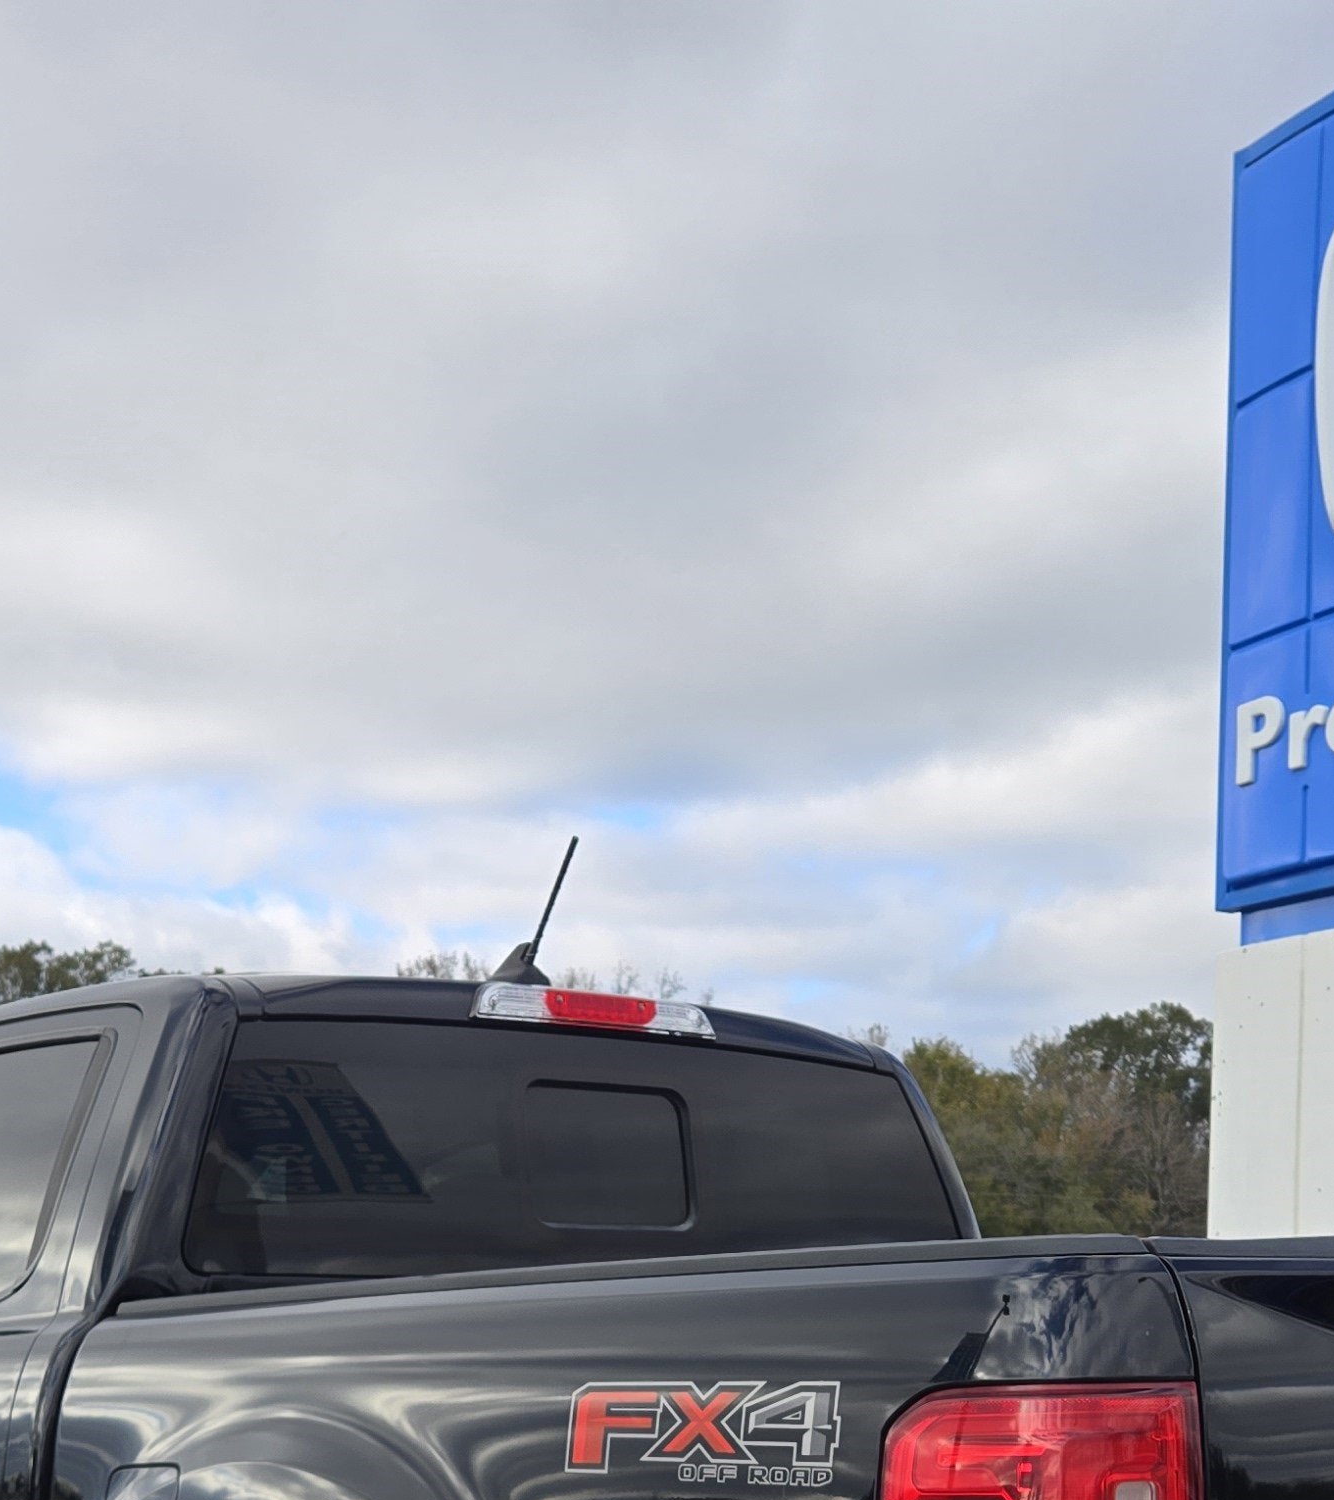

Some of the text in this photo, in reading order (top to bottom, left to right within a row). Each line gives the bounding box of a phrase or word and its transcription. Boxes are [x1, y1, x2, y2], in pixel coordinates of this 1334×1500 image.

[564, 1380, 842, 1475] FX4
[677, 1462, 834, 1487] OFF ROAD
